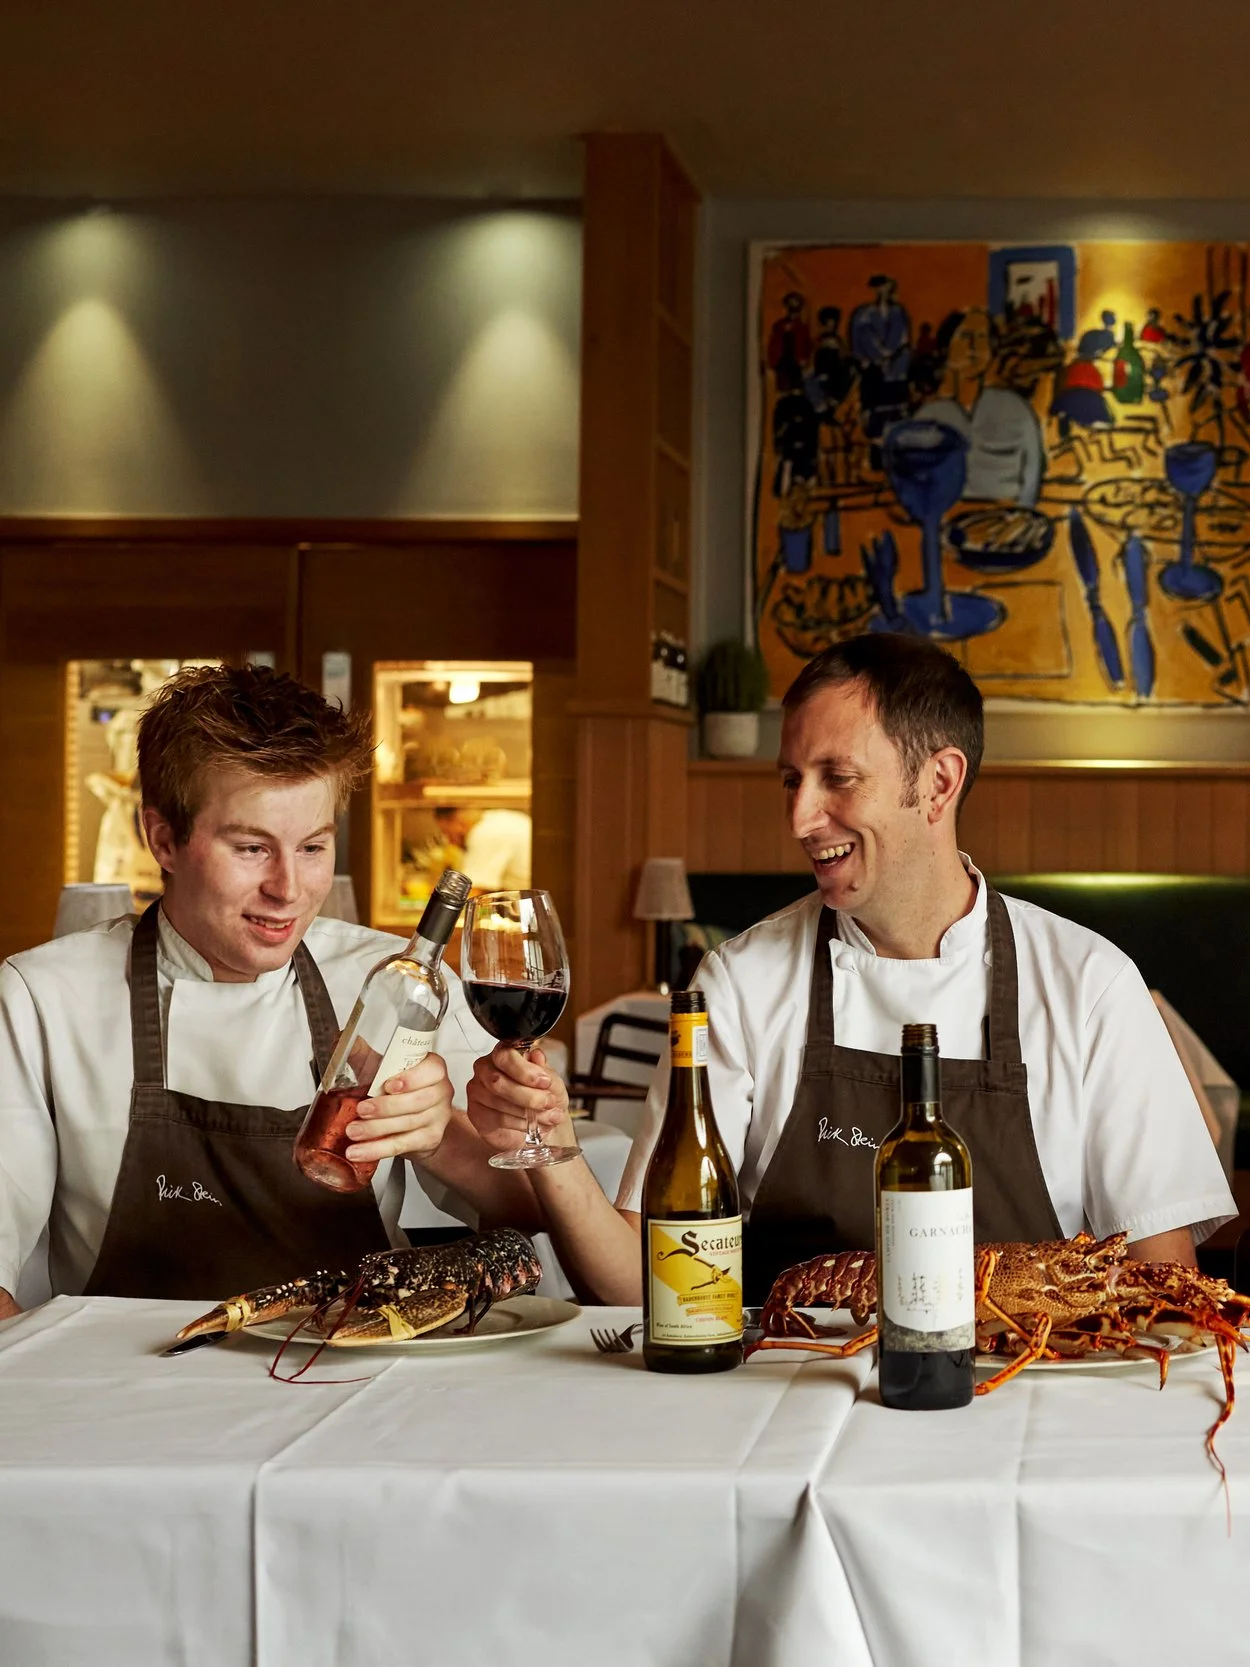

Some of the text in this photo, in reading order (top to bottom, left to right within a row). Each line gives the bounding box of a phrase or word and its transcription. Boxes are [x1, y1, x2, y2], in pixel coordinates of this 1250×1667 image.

[818, 1116, 849, 1147] Rick
[156, 1174, 223, 1207] Rick Stein
